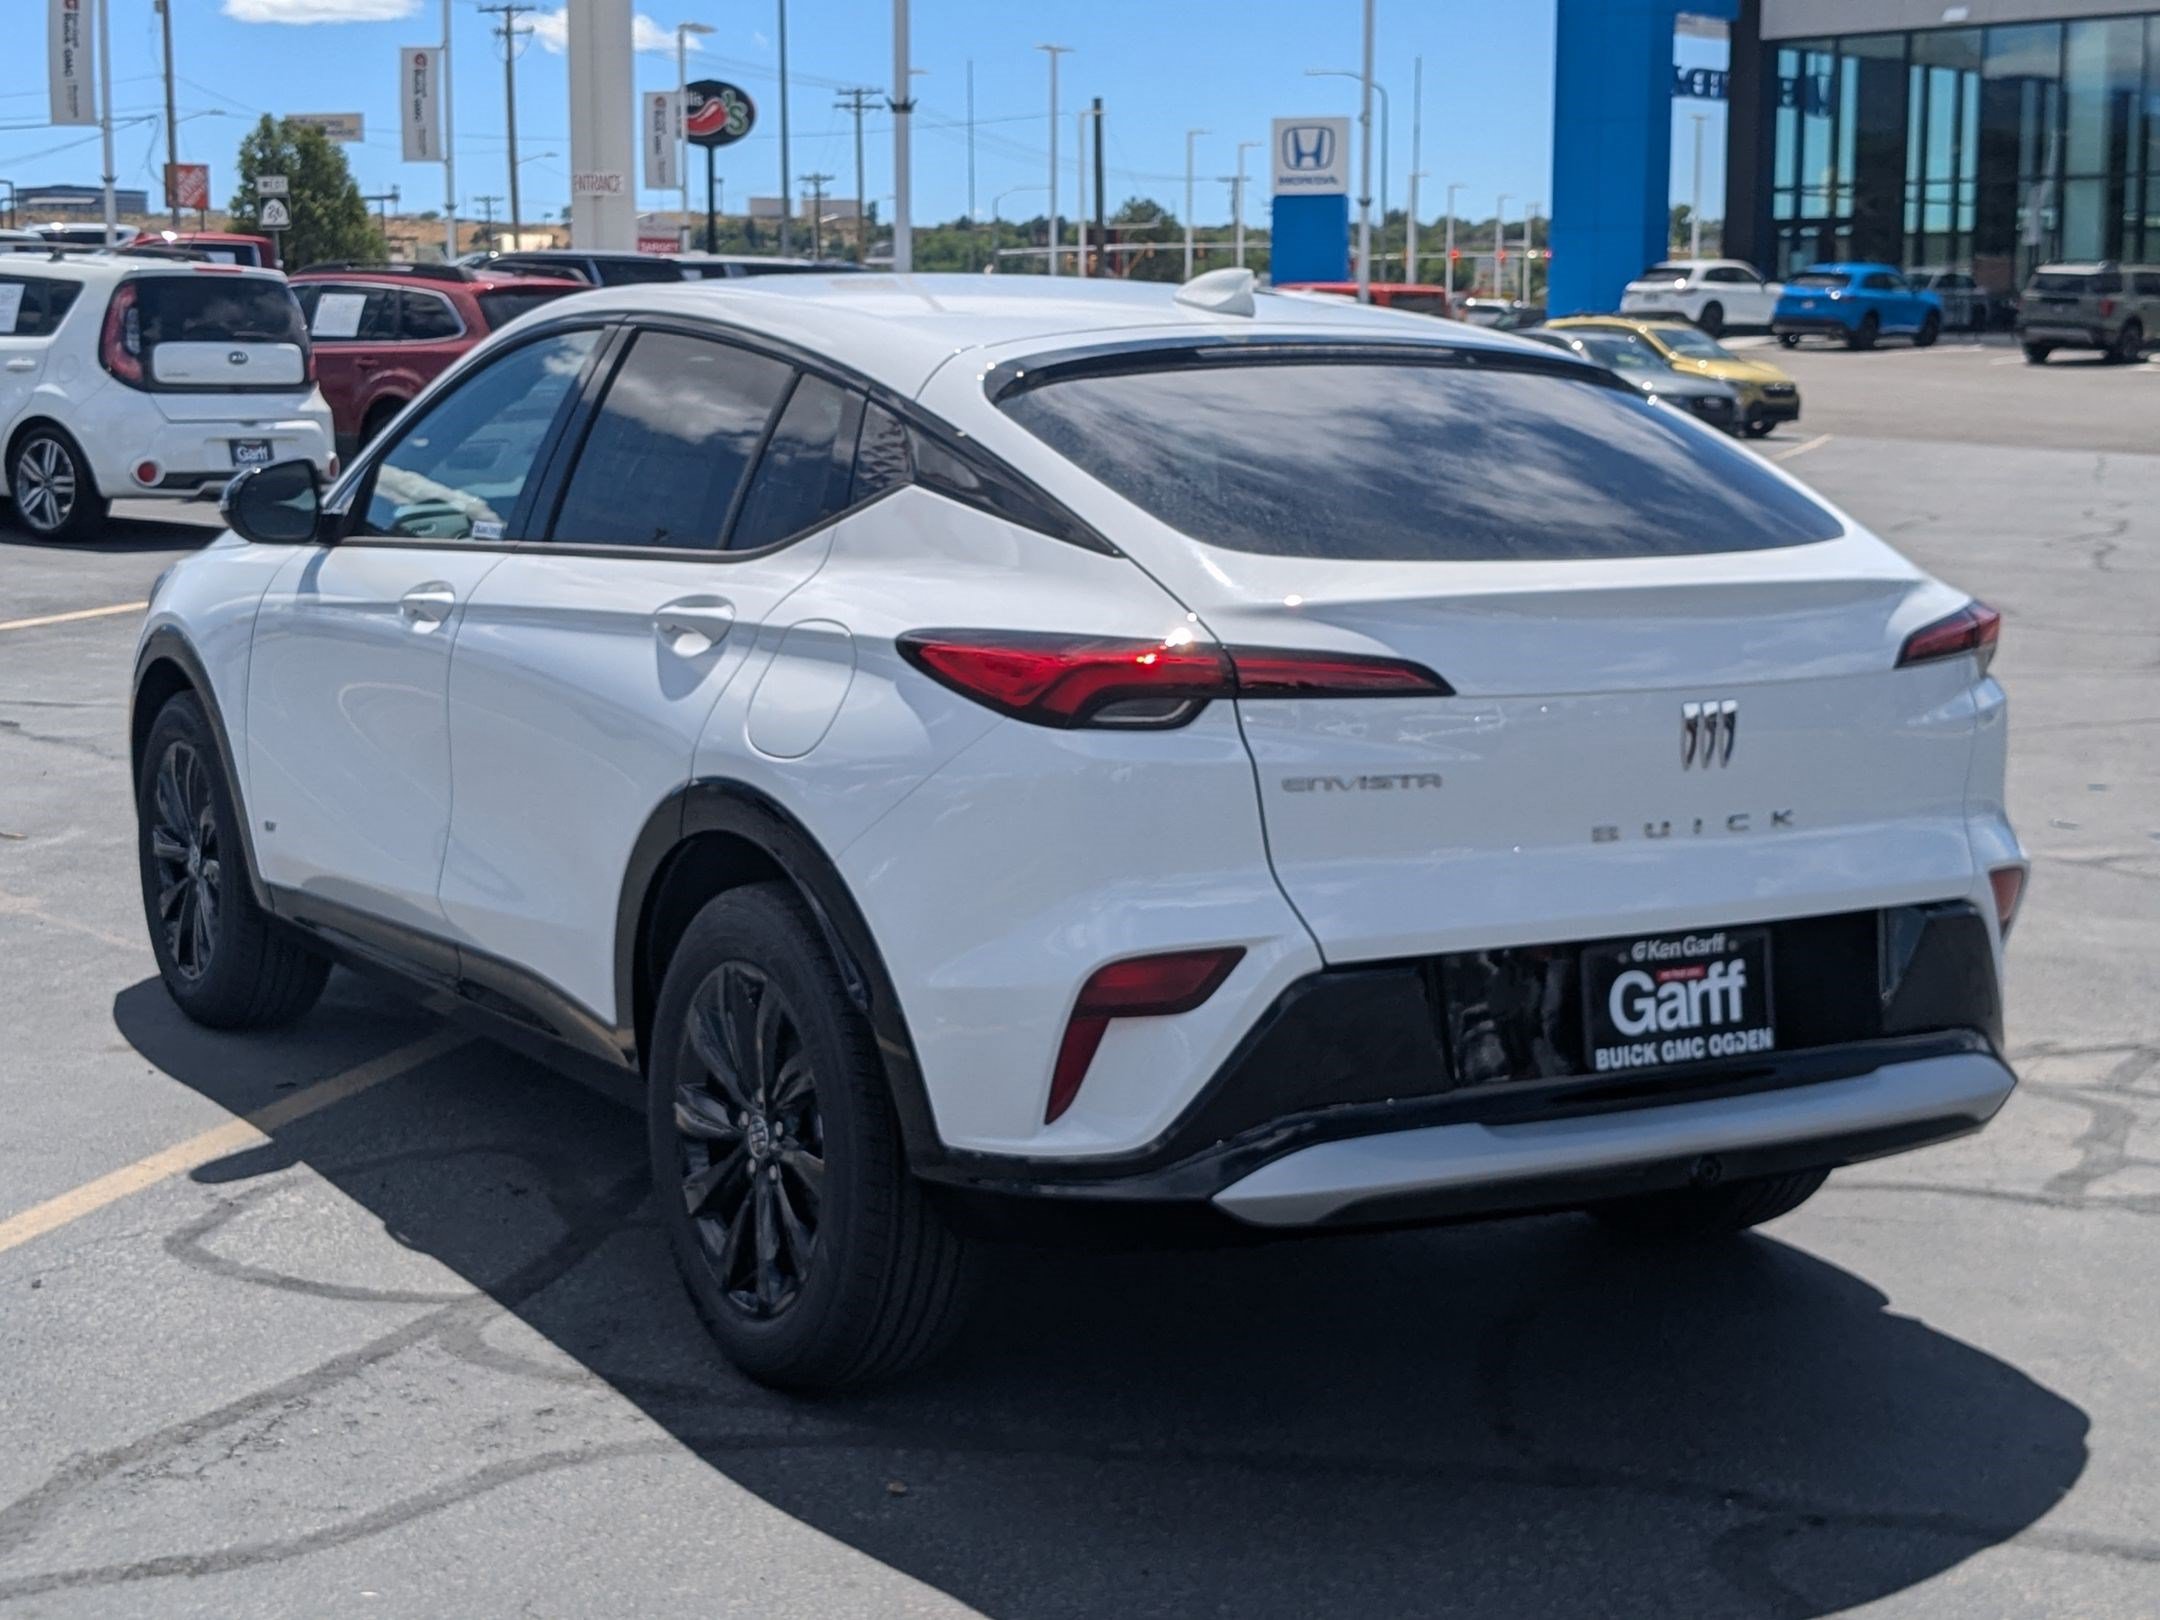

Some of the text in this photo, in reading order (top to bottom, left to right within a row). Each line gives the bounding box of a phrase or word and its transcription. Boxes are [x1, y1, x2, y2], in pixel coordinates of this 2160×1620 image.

[573, 174, 622, 193] ENTRANCE
[1278, 176, 1339, 186] HONDA
[1281, 773, 1443, 793] ENVISTA
[1592, 809, 1794, 843] BUICK
[1647, 939, 1681, 959] Ken
[1683, 933, 1727, 954] Garff
[1609, 958, 1747, 1036] Garff
[1595, 1027, 1774, 1071] BUICK GMC OGDEN
